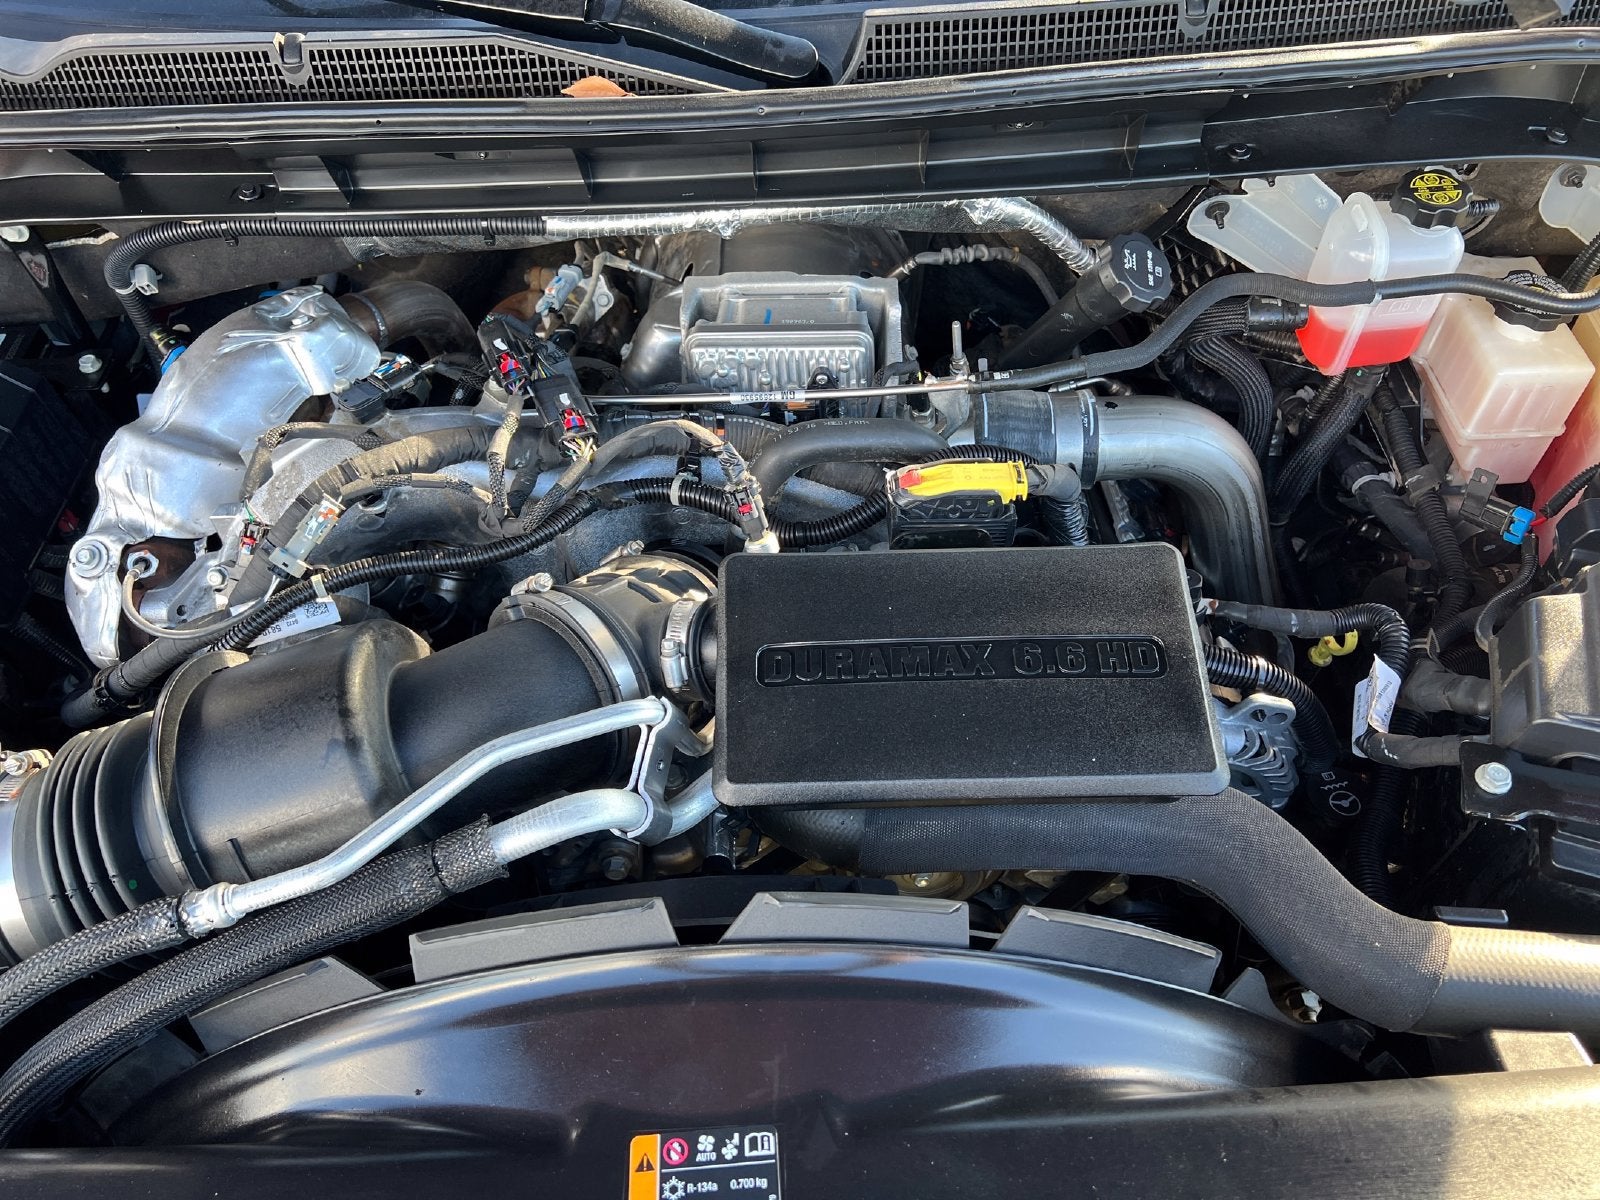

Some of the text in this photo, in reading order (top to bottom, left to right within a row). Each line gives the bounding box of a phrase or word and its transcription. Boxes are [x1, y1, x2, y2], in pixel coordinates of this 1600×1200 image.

[781, 391, 796, 400] GM
[763, 640, 1160, 683] DURAMAX 6.6 HD
[695, 1152, 716, 1162] AUTO
[686, 1177, 768, 1194] R-134a 0.700 kg
